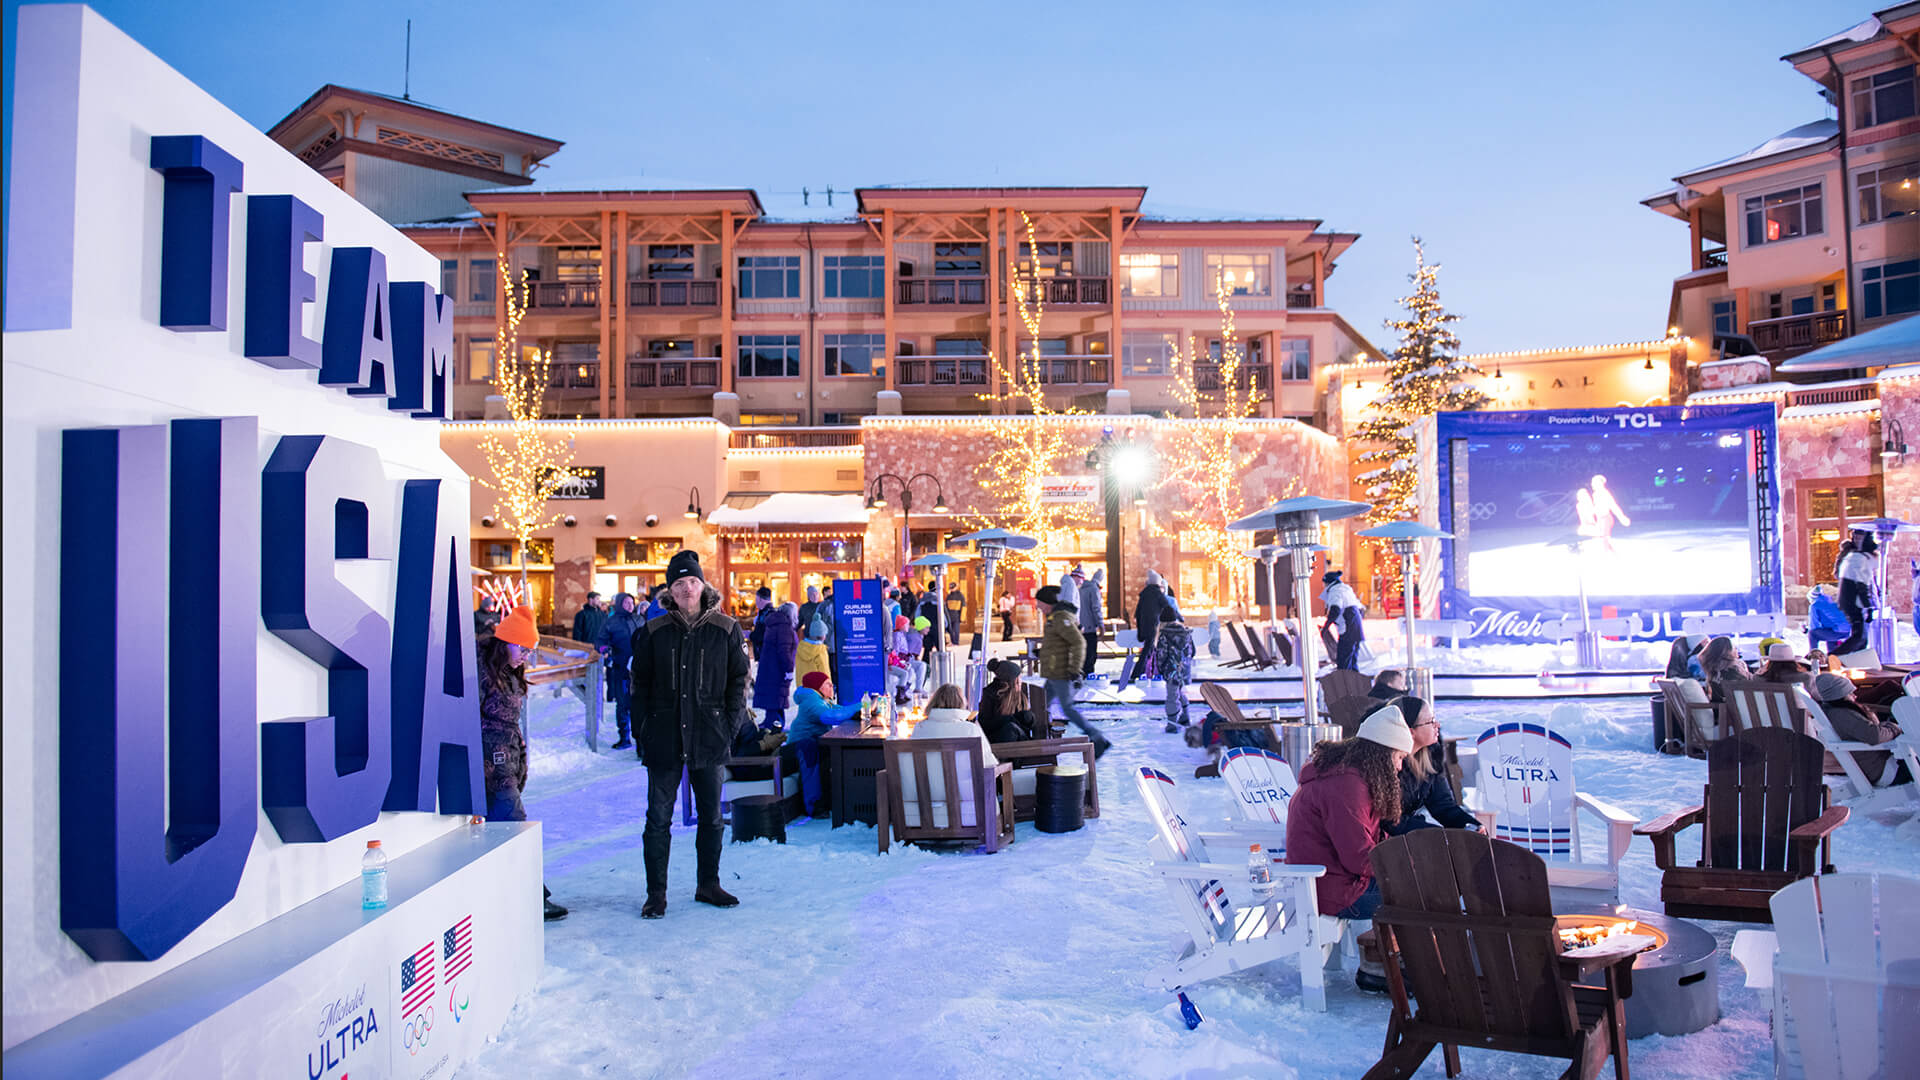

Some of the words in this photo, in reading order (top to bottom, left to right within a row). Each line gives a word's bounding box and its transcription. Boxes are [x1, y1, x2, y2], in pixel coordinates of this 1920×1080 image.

[150, 135, 454, 420] TEAM
[1548, 415, 1595, 425] Powered
[1596, 415, 1610, 425] by
[1614, 413, 1662, 428] TCL
[60, 416, 487, 962] USA
[1491, 766, 1560, 782] ULTRA
[1501, 753, 1544, 767] Micelob
[1240, 786, 1292, 804] ULTRA
[317, 982, 367, 1039] Michelob
[308, 1007, 378, 1080] ULTRA
